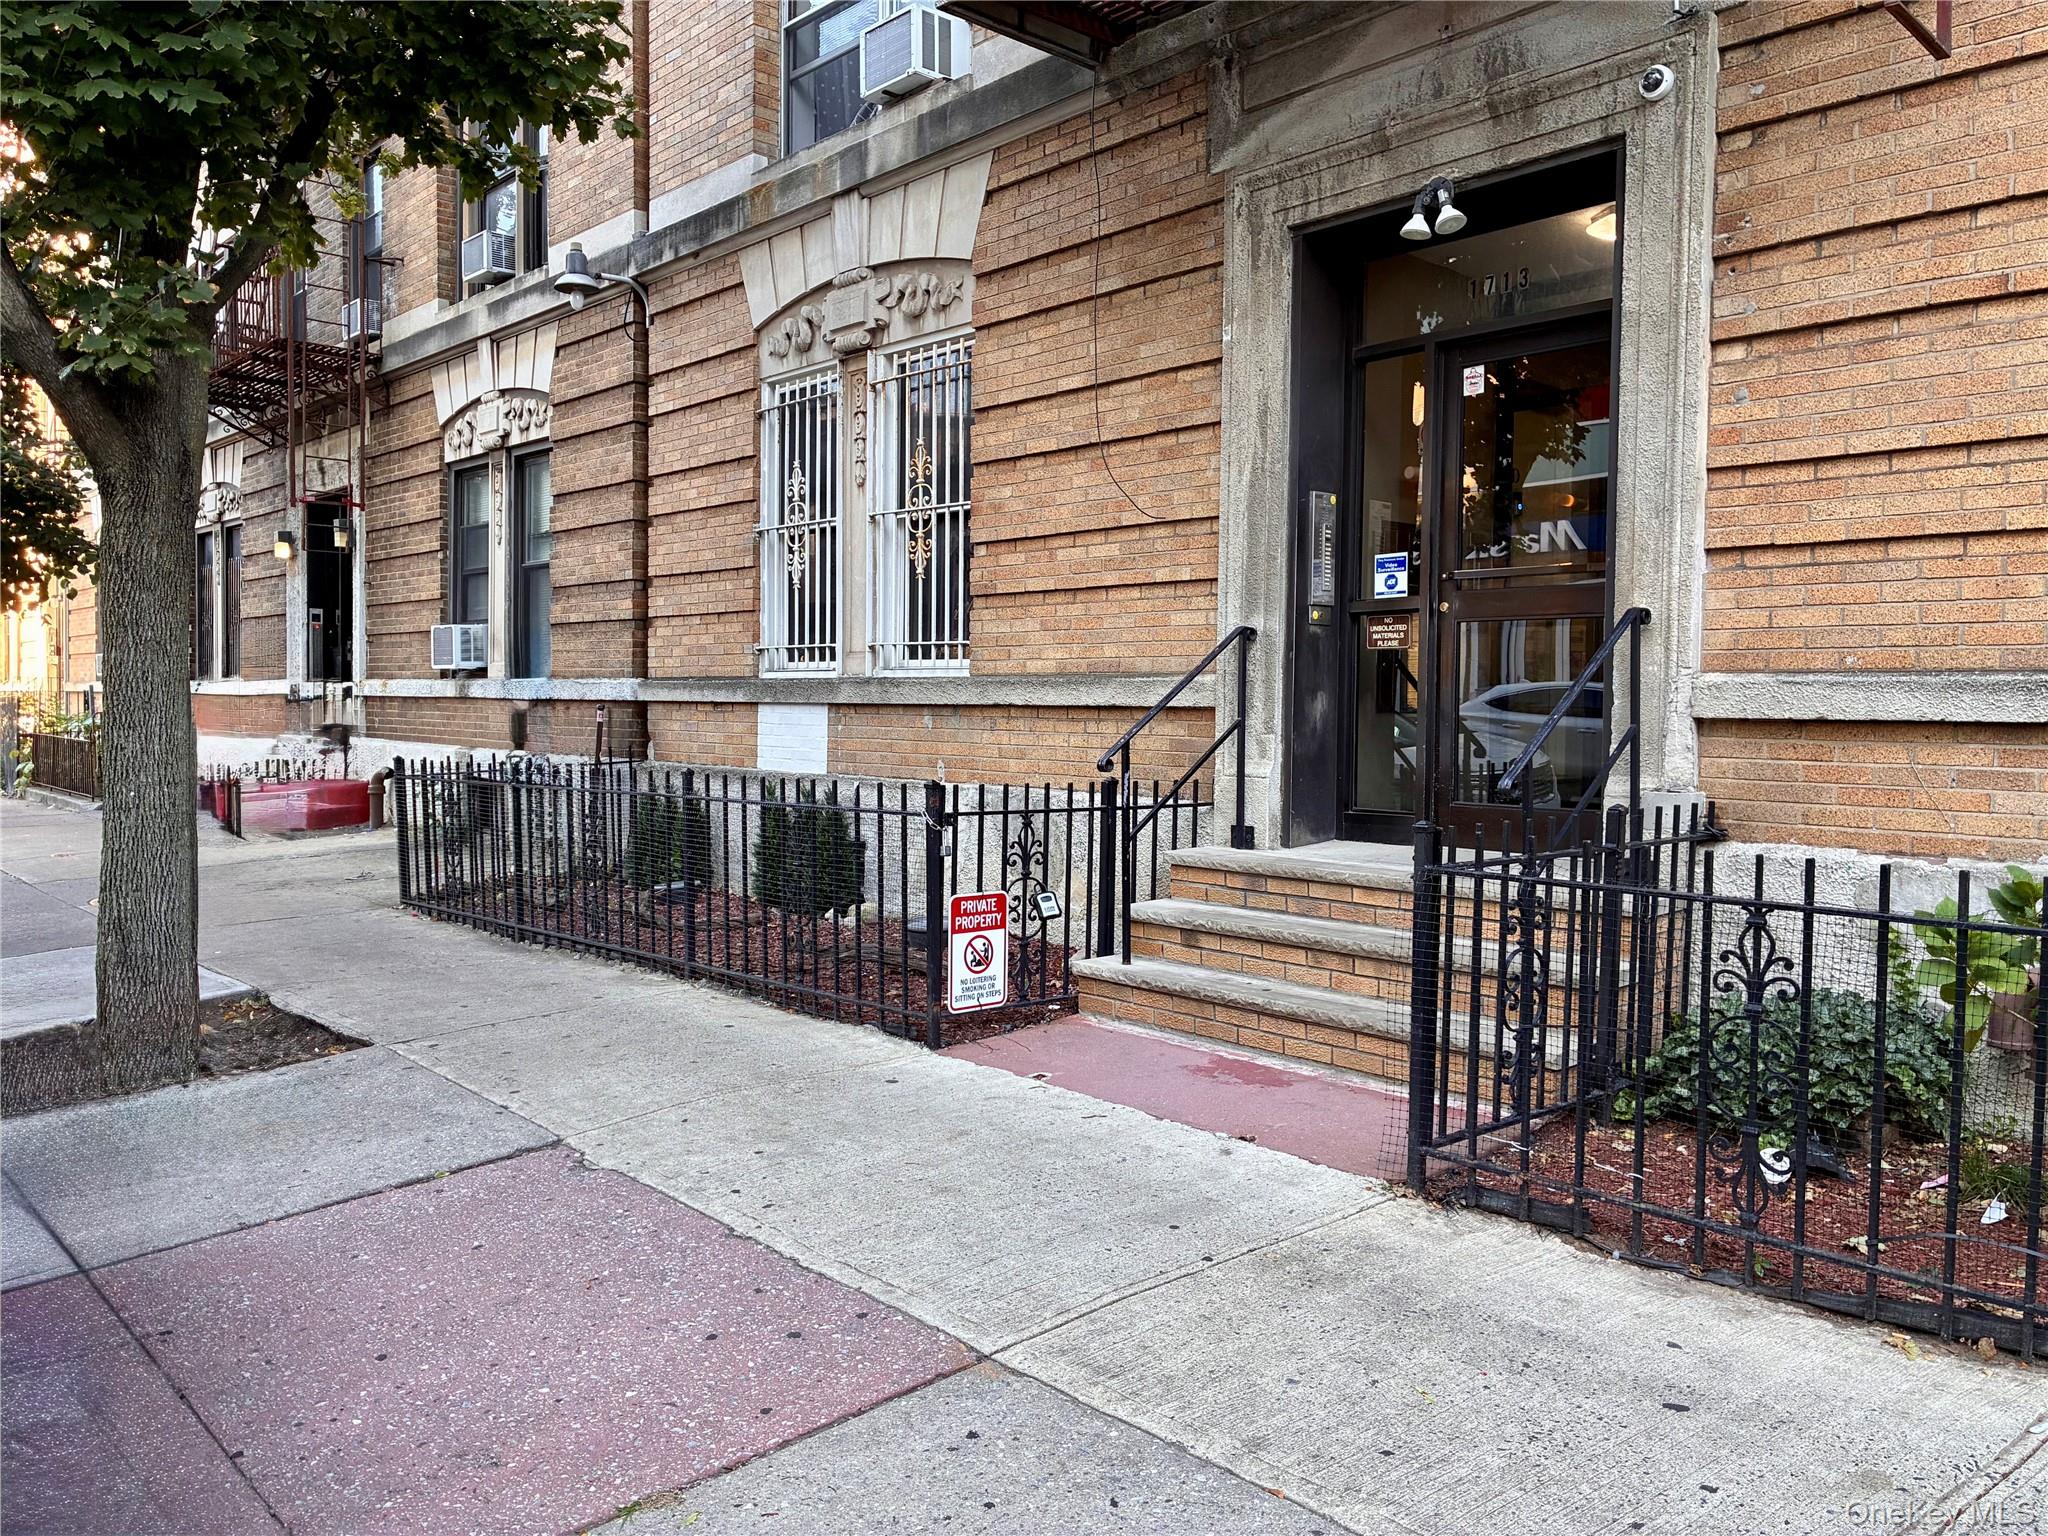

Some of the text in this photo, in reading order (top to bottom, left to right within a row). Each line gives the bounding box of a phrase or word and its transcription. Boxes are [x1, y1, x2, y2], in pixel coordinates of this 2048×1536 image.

[1470, 267, 1529, 299] 1713
[1370, 624, 1407, 632] UNSOLICITED
[960, 898, 997, 914] PRIVATE
[955, 912, 1002, 930] PROPERTY
[970, 975, 996, 984] LOITERING
[961, 984, 986, 993] SMOKING
[955, 993, 975, 1002] SITTING
[986, 989, 1001, 998] STEPS
